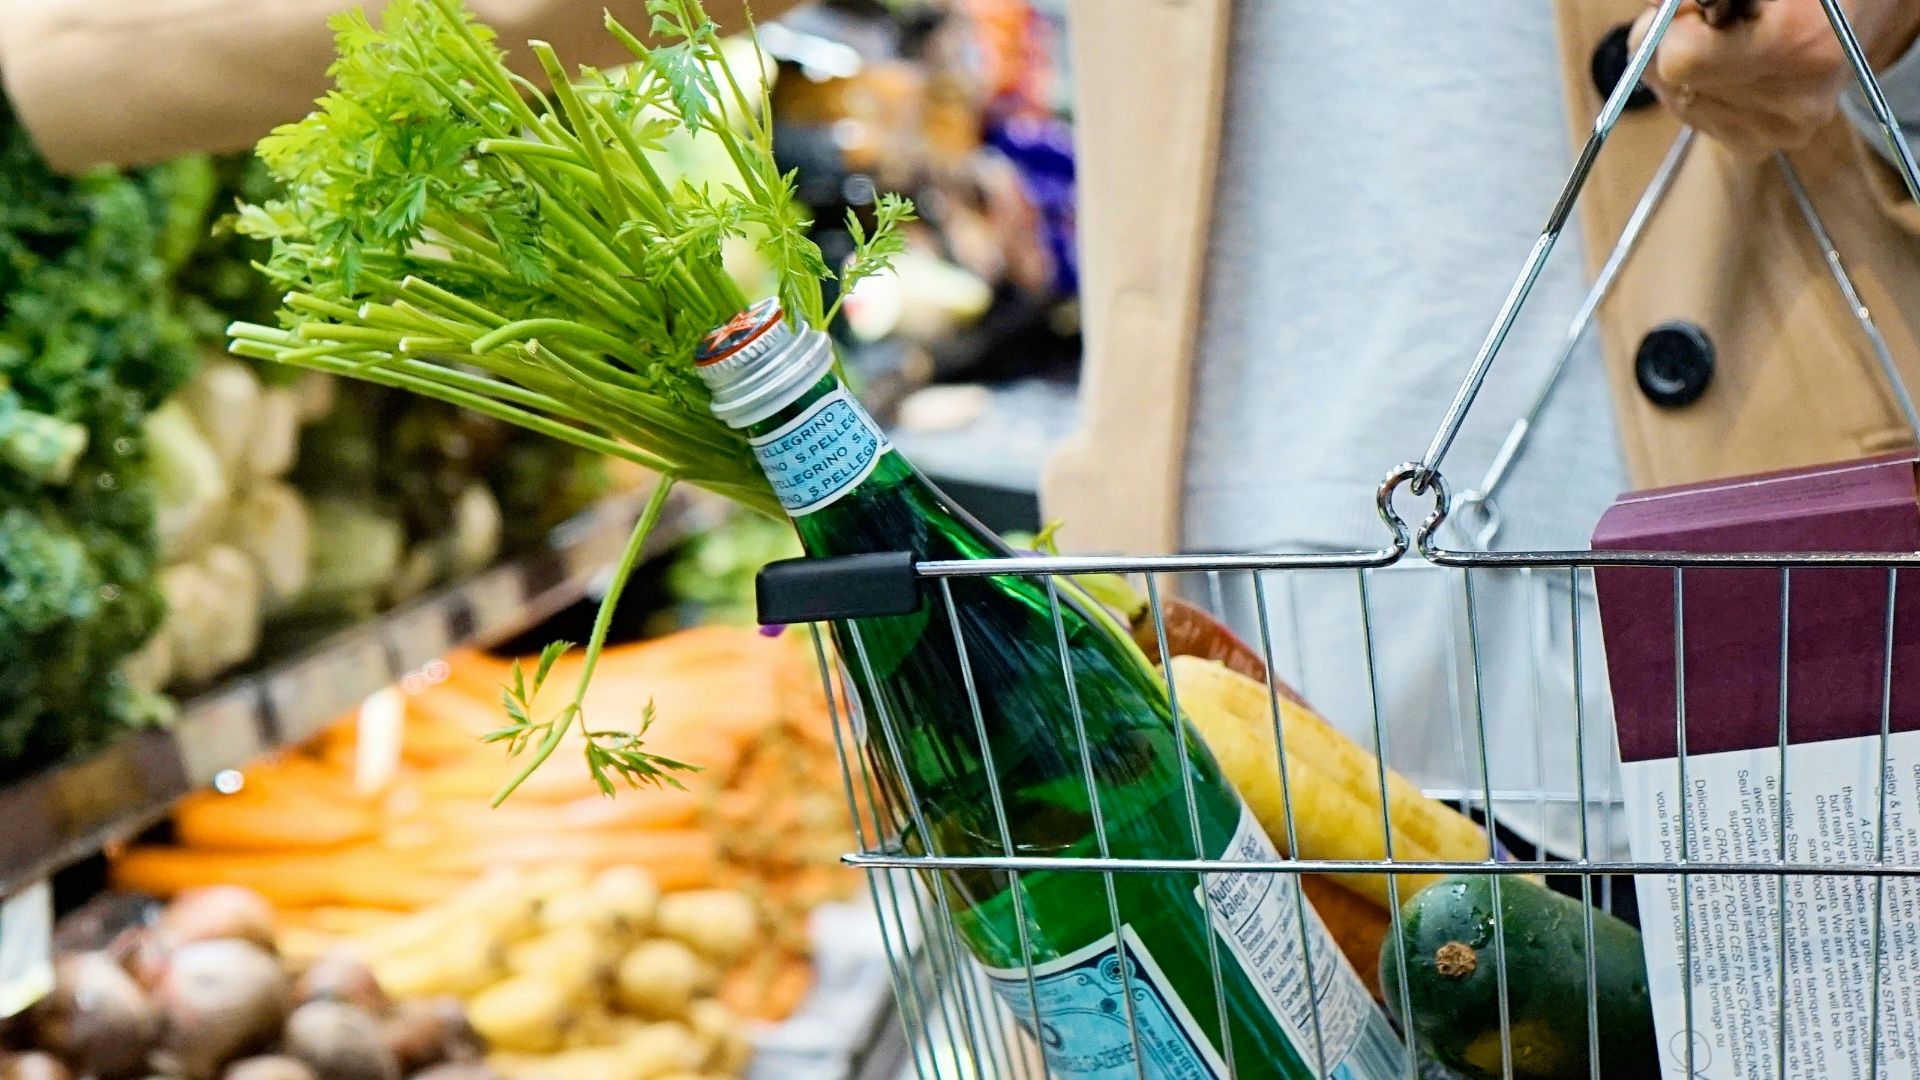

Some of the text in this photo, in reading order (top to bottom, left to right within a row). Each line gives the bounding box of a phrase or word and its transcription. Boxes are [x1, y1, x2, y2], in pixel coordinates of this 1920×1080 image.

[1736, 769, 1751, 795] Seul
[1765, 775, 1776, 790] de
[1655, 791, 1667, 819] vous
[1694, 779, 1709, 832] Délicieux
[1741, 798, 1751, 814] un
[1752, 786, 1764, 814] avec
[1828, 794, 1840, 812] but
[1841, 785, 1853, 818] these
[1660, 821, 1669, 836] ne
[1815, 794, 1828, 837] cheese
[1859, 817, 1870, 826] A
[1891, 811, 1902, 831] her
[1702, 835, 1712, 850] au
[1741, 817, 1758, 857] produit
[1756, 817, 1768, 845] soin,
[1831, 815, 1845, 846] really
[1846, 821, 1860, 861] unique
[1761, 848, 1770, 863] en
[1787, 832, 1800, 865] Stow
[1821, 840, 1830, 851] or
[1861, 829, 1875, 865] CRIS
[1894, 835, 1906, 865] team
[1695, 885, 1706, 900] de
[1736, 874, 1752, 916] pouvait
[1765, 872, 1778, 905] etites
[1822, 855, 1838, 912] apasto.
[1854, 874, 1867, 913] ackers
[1218, 883, 1249, 920] Valeur
[1666, 887, 1680, 911] plus
[1710, 899, 1721, 920] ces
[1816, 903, 1826, 912] &
[1841, 884, 1853, 915] when
[1887, 884, 1901, 926] scratch
[1902, 899, 1913, 918] the
[1723, 894, 1739, 932] POUR
[1796, 901, 1809, 937] Foods
[1817, 916, 1827, 934] are
[1831, 913, 1842, 933] We
[1858, 916, 1869, 935] are
[1697, 903, 1713, 961] trempette,
[1755, 905, 1771, 952] fabriqué
[1844, 918, 1860, 958] topped
[1905, 921, 1917, 945] only
[1714, 922, 1730, 982] craquelins
[1729, 935, 1744, 962] CES
[1743, 919, 1758, 971] satisfaire
[1801, 940, 1813, 973] adore
[1820, 938, 1831, 963] sure
[1834, 936, 1844, 955] are
[1892, 929, 1904, 961] using
[1706, 964, 1716, 979] de
[1762, 955, 1772, 981] avec
[1851, 961, 1863, 984] with
[1909, 948, 1919, 971] way
[1733, 965, 1747, 994] FINS
[1822, 967, 1834, 988] you
[1836, 958, 1853, 1008] addicted
[1898, 964, 1907, 982] our
[1708, 982, 1723, 1029] fromage
[1723, 985, 1734, 1010] sont
[1750, 974, 1763, 1011] Lesley
[1766, 985, 1777, 1007] des
[1785, 926, 1799, 974] fabuleux
[1792, 977, 1808, 1037] craquelins
[1801, 1040, 1812, 1064] sont
[1806, 976, 1820, 1027] fabriquer
[1827, 991, 1839, 1009] will
[1852, 988, 1865, 1012] your
[1900, 985, 1913, 1017] finest
[1756, 1014, 1767, 1025] et
[1830, 1012, 1840, 1027] be
[1844, 1010, 1854, 1022] to
[1715, 1032, 1724, 1047] ou
[1757, 1028, 1769, 1050] son
[1813, 1031, 1823, 1042] et
[1846, 1025, 1857, 1045] this
[1789, 1055, 1800, 1070] de
[1815, 1045, 1826, 1073] vous
